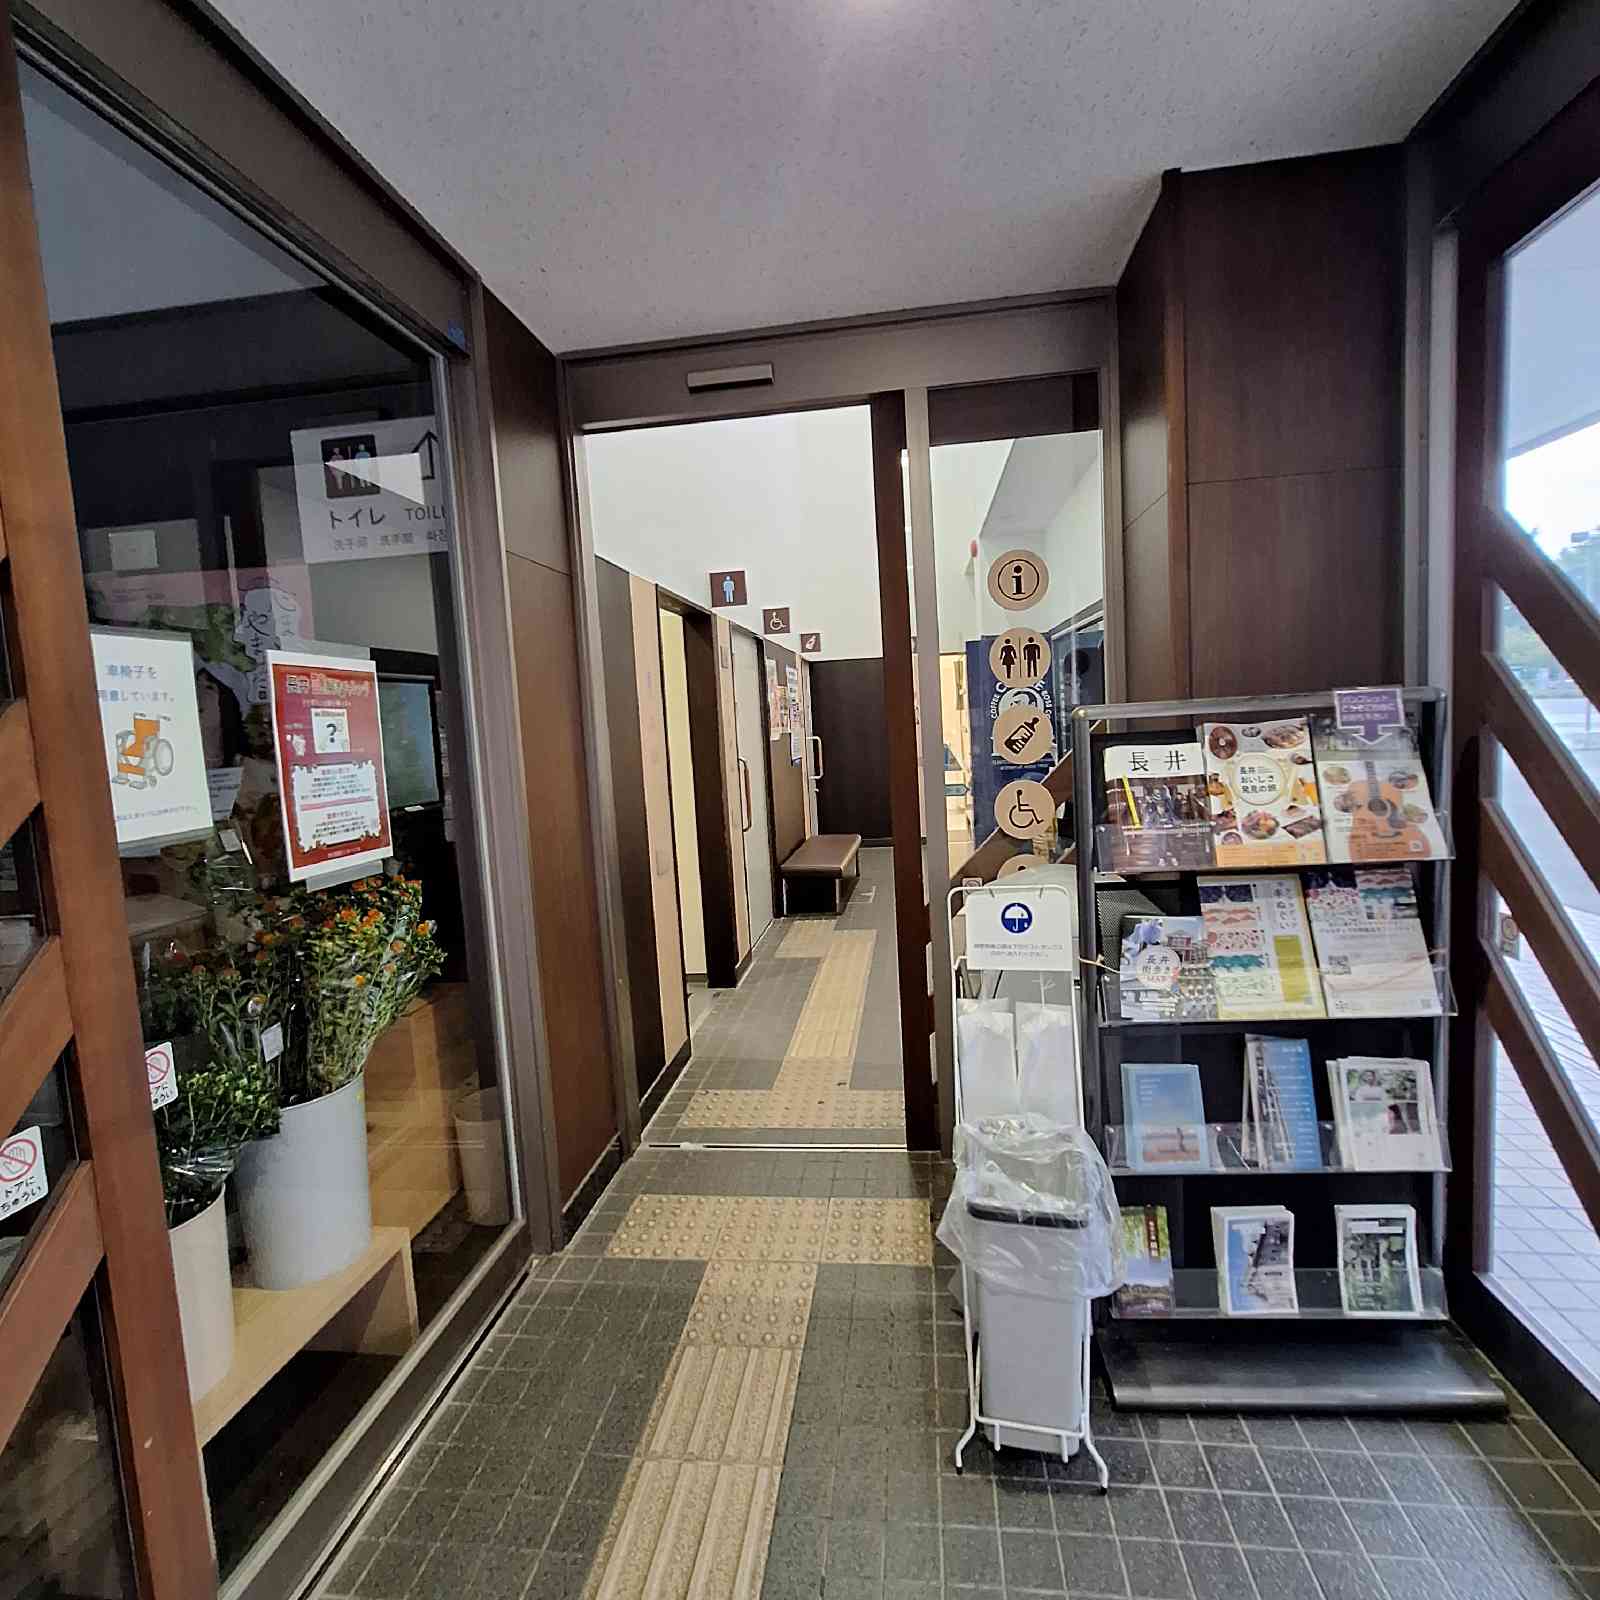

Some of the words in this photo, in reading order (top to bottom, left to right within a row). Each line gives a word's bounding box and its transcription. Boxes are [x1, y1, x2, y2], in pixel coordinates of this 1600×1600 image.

[329, 507, 386, 529] トイレ
[404, 505, 446, 520] TOIL
[1128, 750, 1187, 771] 長井
[1146, 953, 1170, 965] 長井
[152, 1083, 169, 1097] アに
[4, 1176, 37, 1199] ドアに
[0, 1186, 43, 1213] ちゅうい
